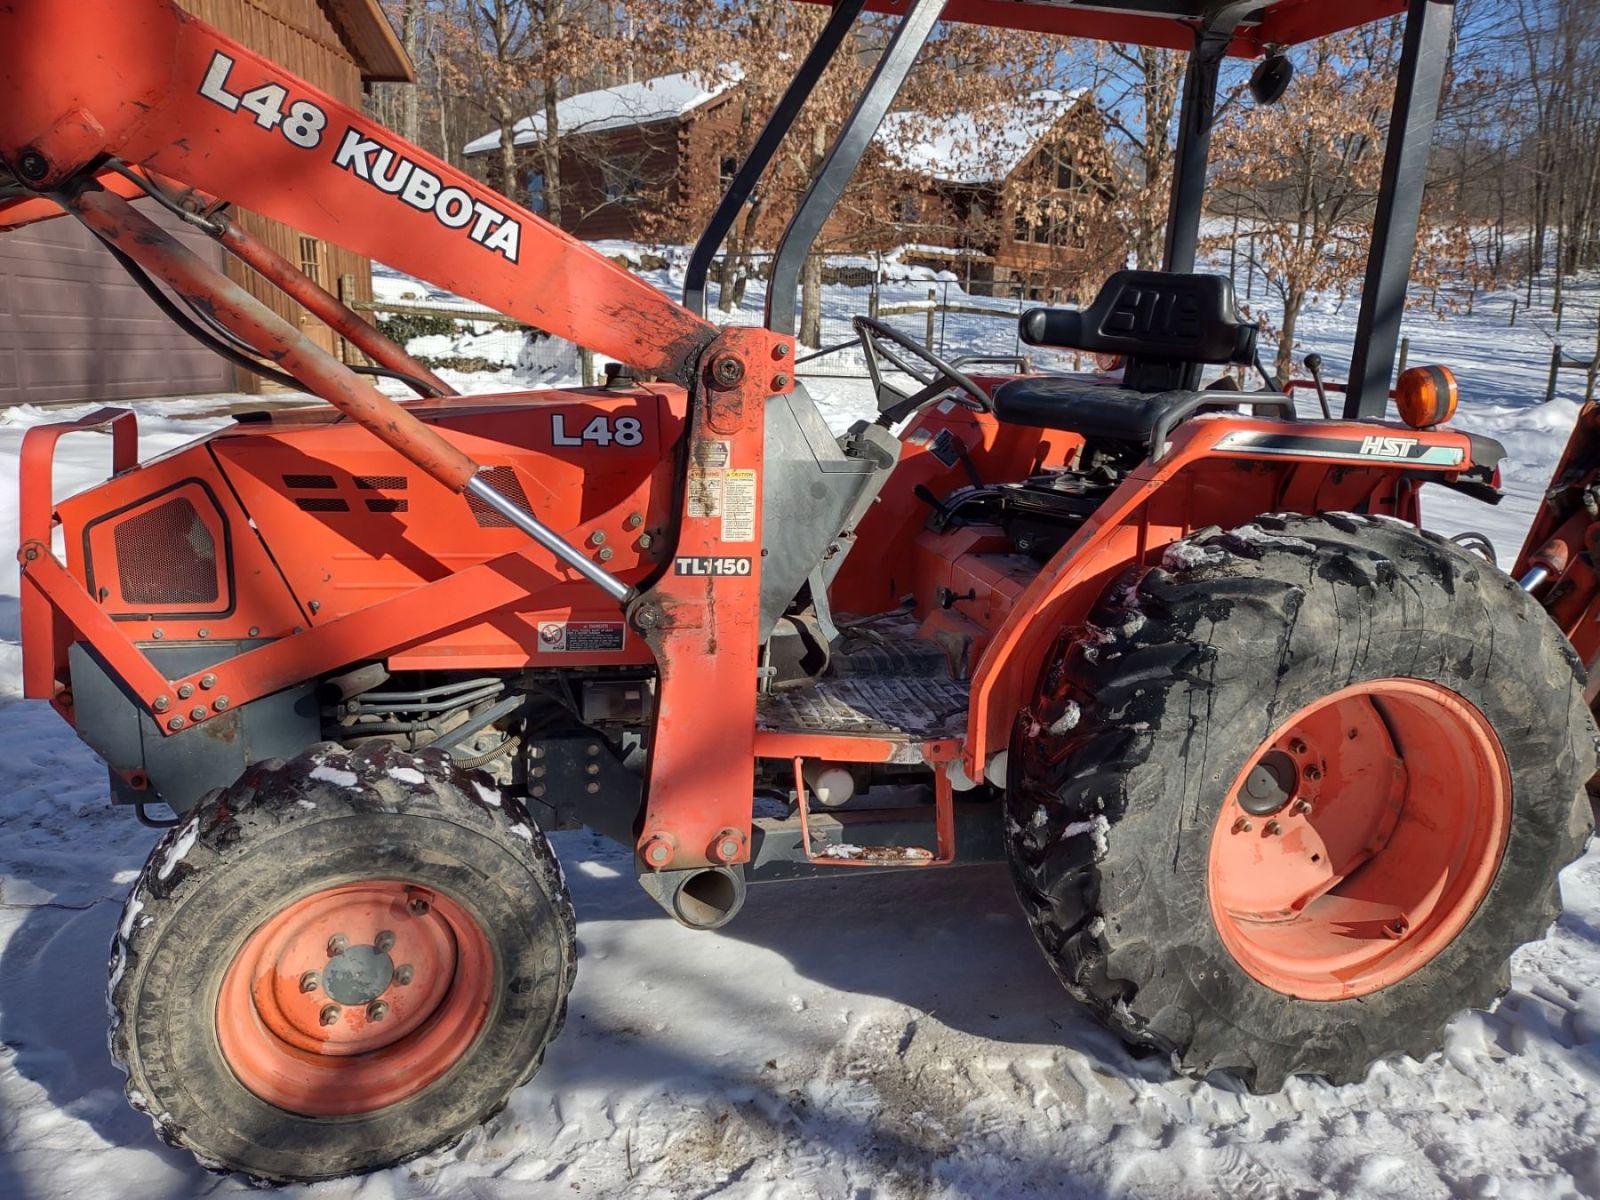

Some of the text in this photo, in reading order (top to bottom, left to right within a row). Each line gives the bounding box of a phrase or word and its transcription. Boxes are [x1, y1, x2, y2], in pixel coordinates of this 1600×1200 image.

[199, 51, 521, 263] L48 KUBOTA
[551, 414, 644, 447] L48
[1359, 435, 1418, 458] HST
[676, 558, 750, 575] TL1150
